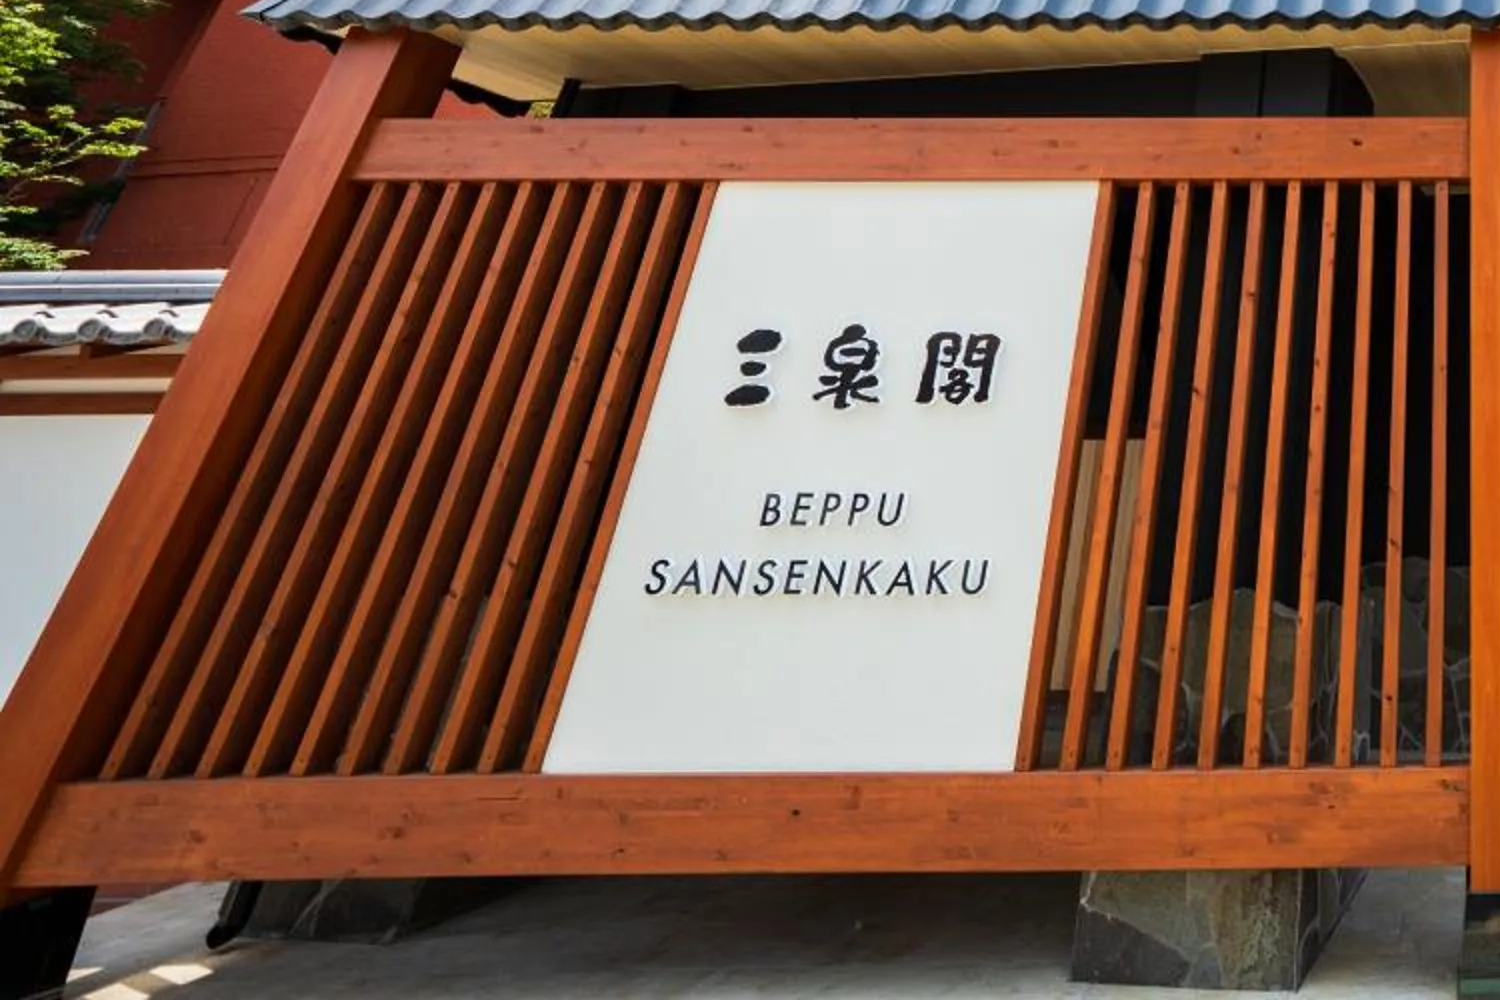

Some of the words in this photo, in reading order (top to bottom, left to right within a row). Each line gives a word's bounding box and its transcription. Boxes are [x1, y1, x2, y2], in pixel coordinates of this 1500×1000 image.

[723, 323, 1001, 410] 三泉閣
[760, 492, 905, 527] BEPPU
[644, 559, 989, 597] SANSENKAKU
